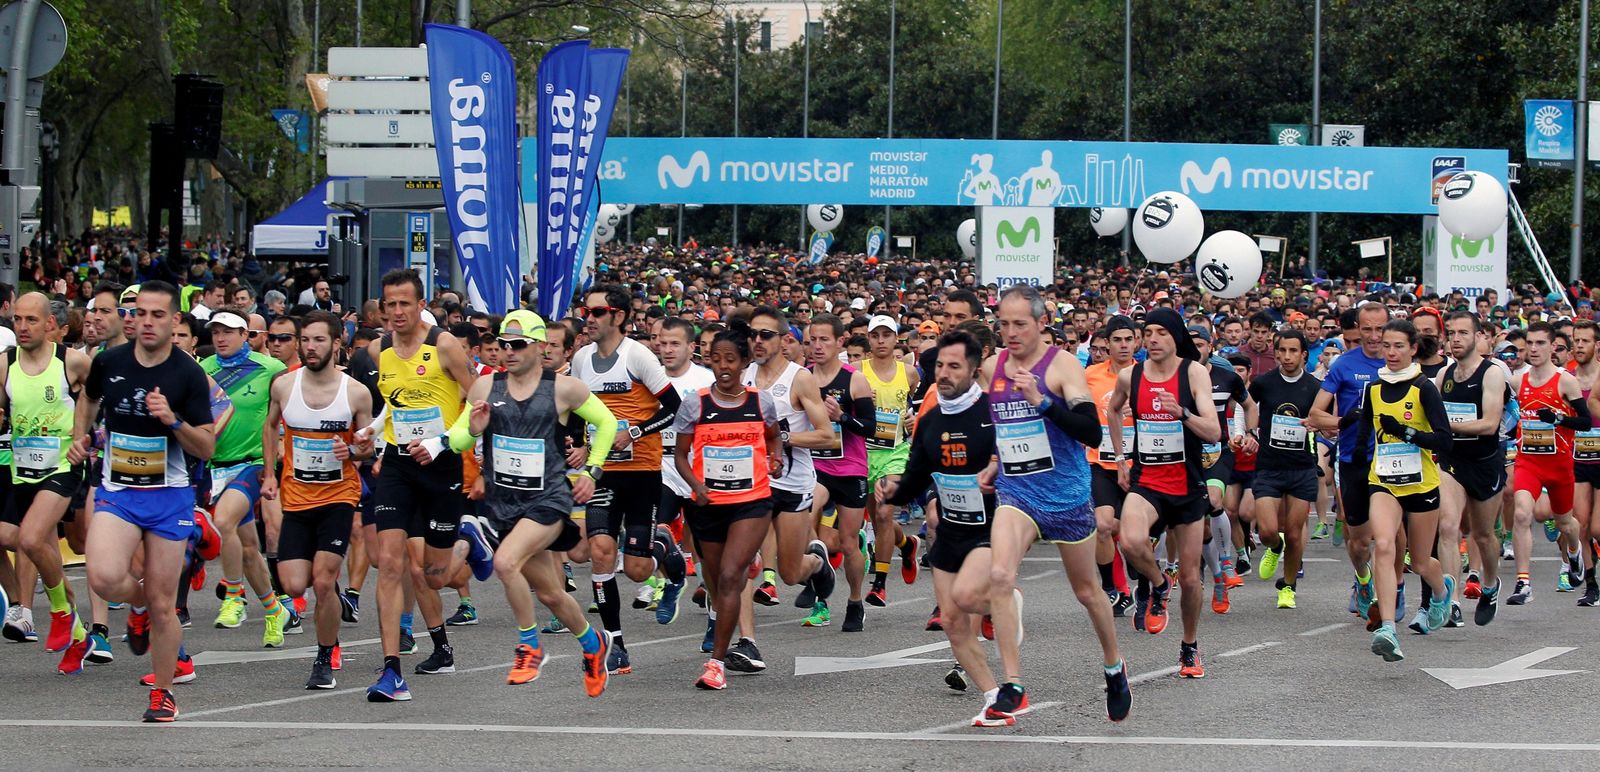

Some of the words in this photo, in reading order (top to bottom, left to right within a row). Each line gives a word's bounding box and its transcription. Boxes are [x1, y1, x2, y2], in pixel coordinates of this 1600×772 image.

[870, 152, 928, 161] movistar
[1434, 159, 1458, 167] IAAF
[720, 158, 854, 183] movistar
[870, 165, 908, 175] MEDIO
[870, 174, 928, 186] MARATÓN
[1242, 167, 1374, 191] movistar
[870, 188, 915, 198] MADRID
[995, 254, 1041, 263] movistar
[1450, 263, 1494, 272] movistar
[412, 426, 424, 435] 45
[1283, 429, 1296, 437] 144
[716, 432, 760, 441] ALBACETE
[1153, 438, 1164, 447] 82
[1011, 443, 1029, 454] 110
[28, 453, 44, 463] 105
[127, 455, 147, 467] 485
[311, 455, 323, 464] 74
[510, 457, 521, 468] 73
[1392, 459, 1402, 468] 61
[721, 464, 734, 473] 40
[946, 493, 967, 504] 1291
